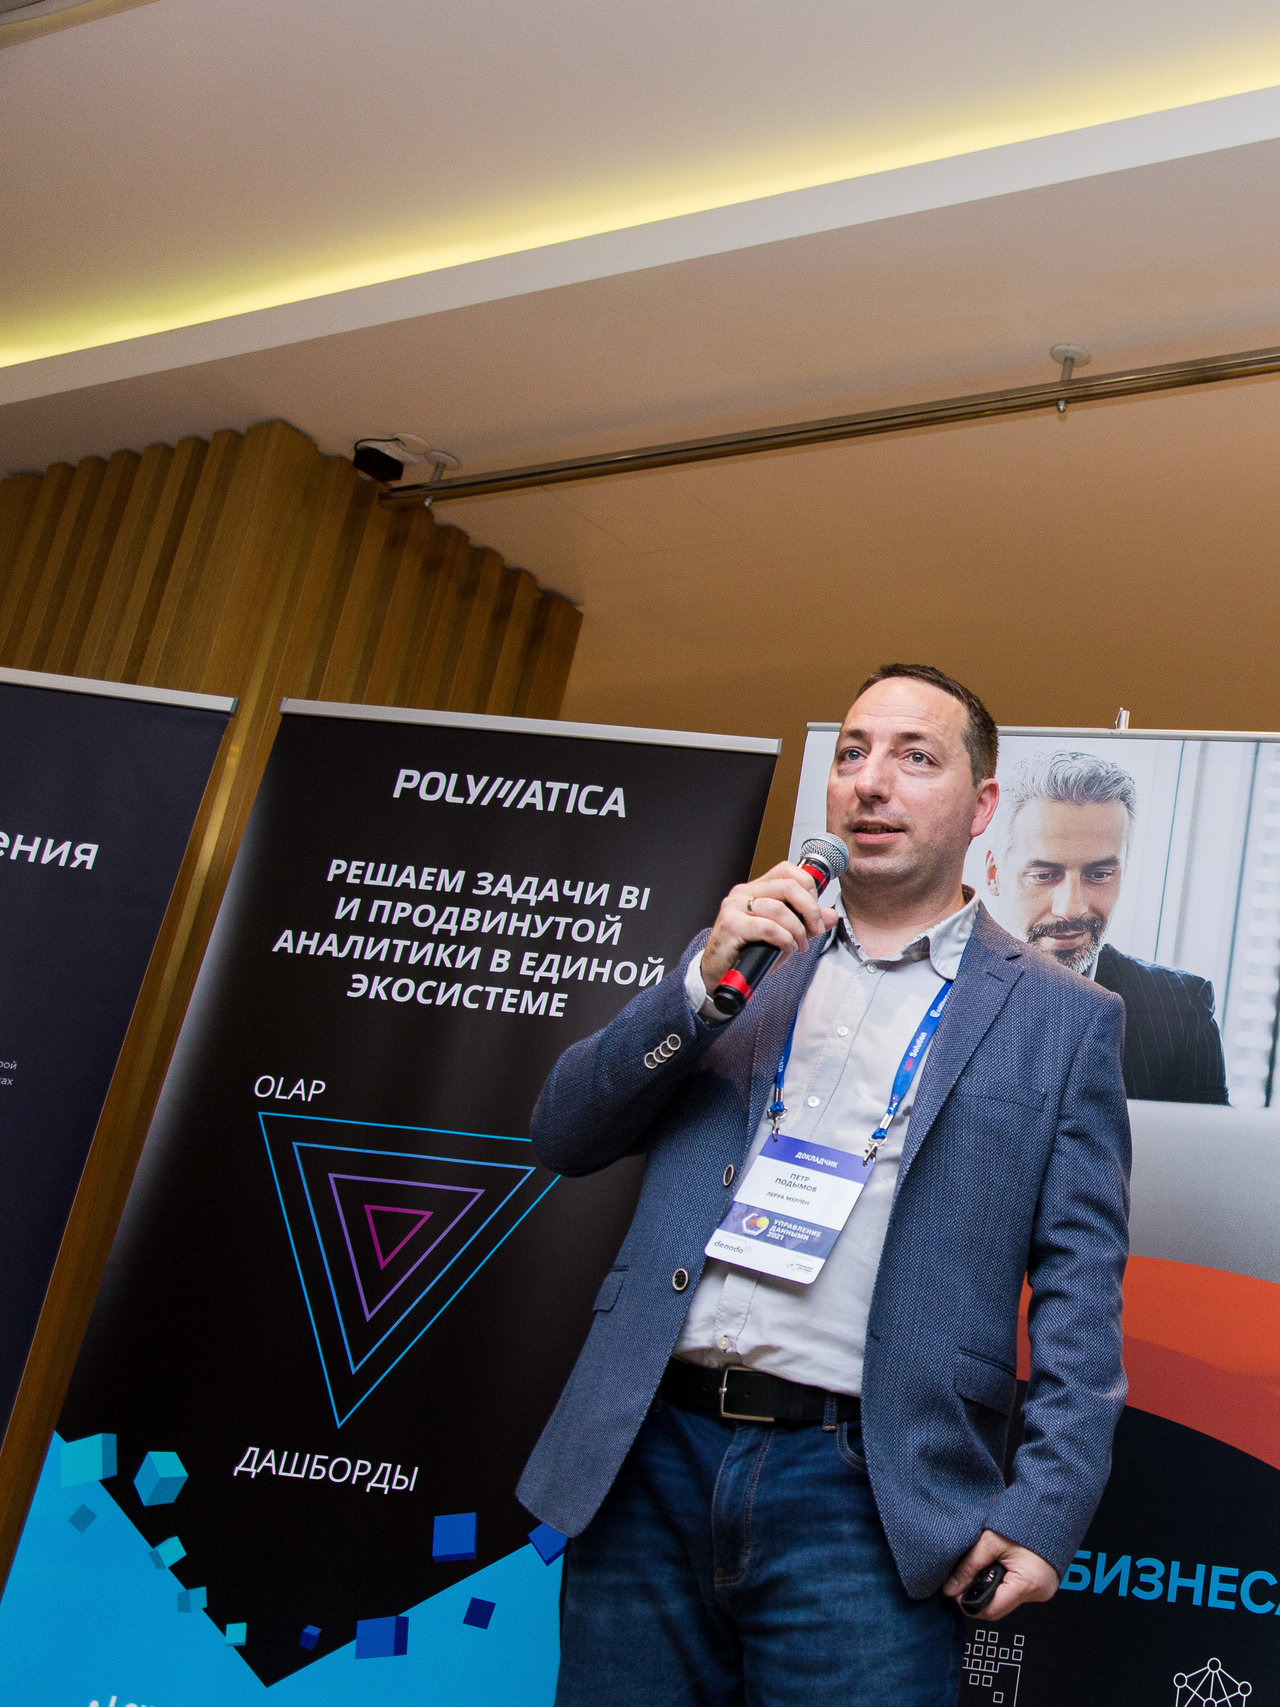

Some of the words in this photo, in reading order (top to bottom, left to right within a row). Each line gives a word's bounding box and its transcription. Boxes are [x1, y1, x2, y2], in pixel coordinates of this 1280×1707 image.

[326, 858, 467, 894] РЕШАЕМ
[472, 871, 610, 907] ЗАДАЧИ
[618, 885, 651, 912] BI
[334, 896, 362, 922] И
[367, 899, 623, 946] ПРОДВИНУТОЙ
[271, 929, 482, 971] АНАЛИТИКИ
[489, 948, 512, 974] В
[519, 951, 666, 988] ЕДИНОЙ
[346, 973, 569, 1018] ЭКОСИСТЕМЕ
[253, 1074, 327, 1102] OLAP
[794, 1150, 839, 1169] ДОКЛАДЧИК
[774, 1177, 818, 1193] ПОДЫМОВ
[789, 1172, 810, 1183] ПЕТР
[766, 1231, 785, 1241] 2021
[769, 1225, 810, 1241] ДАННЫМИ
[773, 1219, 823, 1238] УПРАВЛЕНИЕ
[714, 1240, 744, 1254] denodo
[232, 1446, 419, 1495] ДАШБОРДЫ
